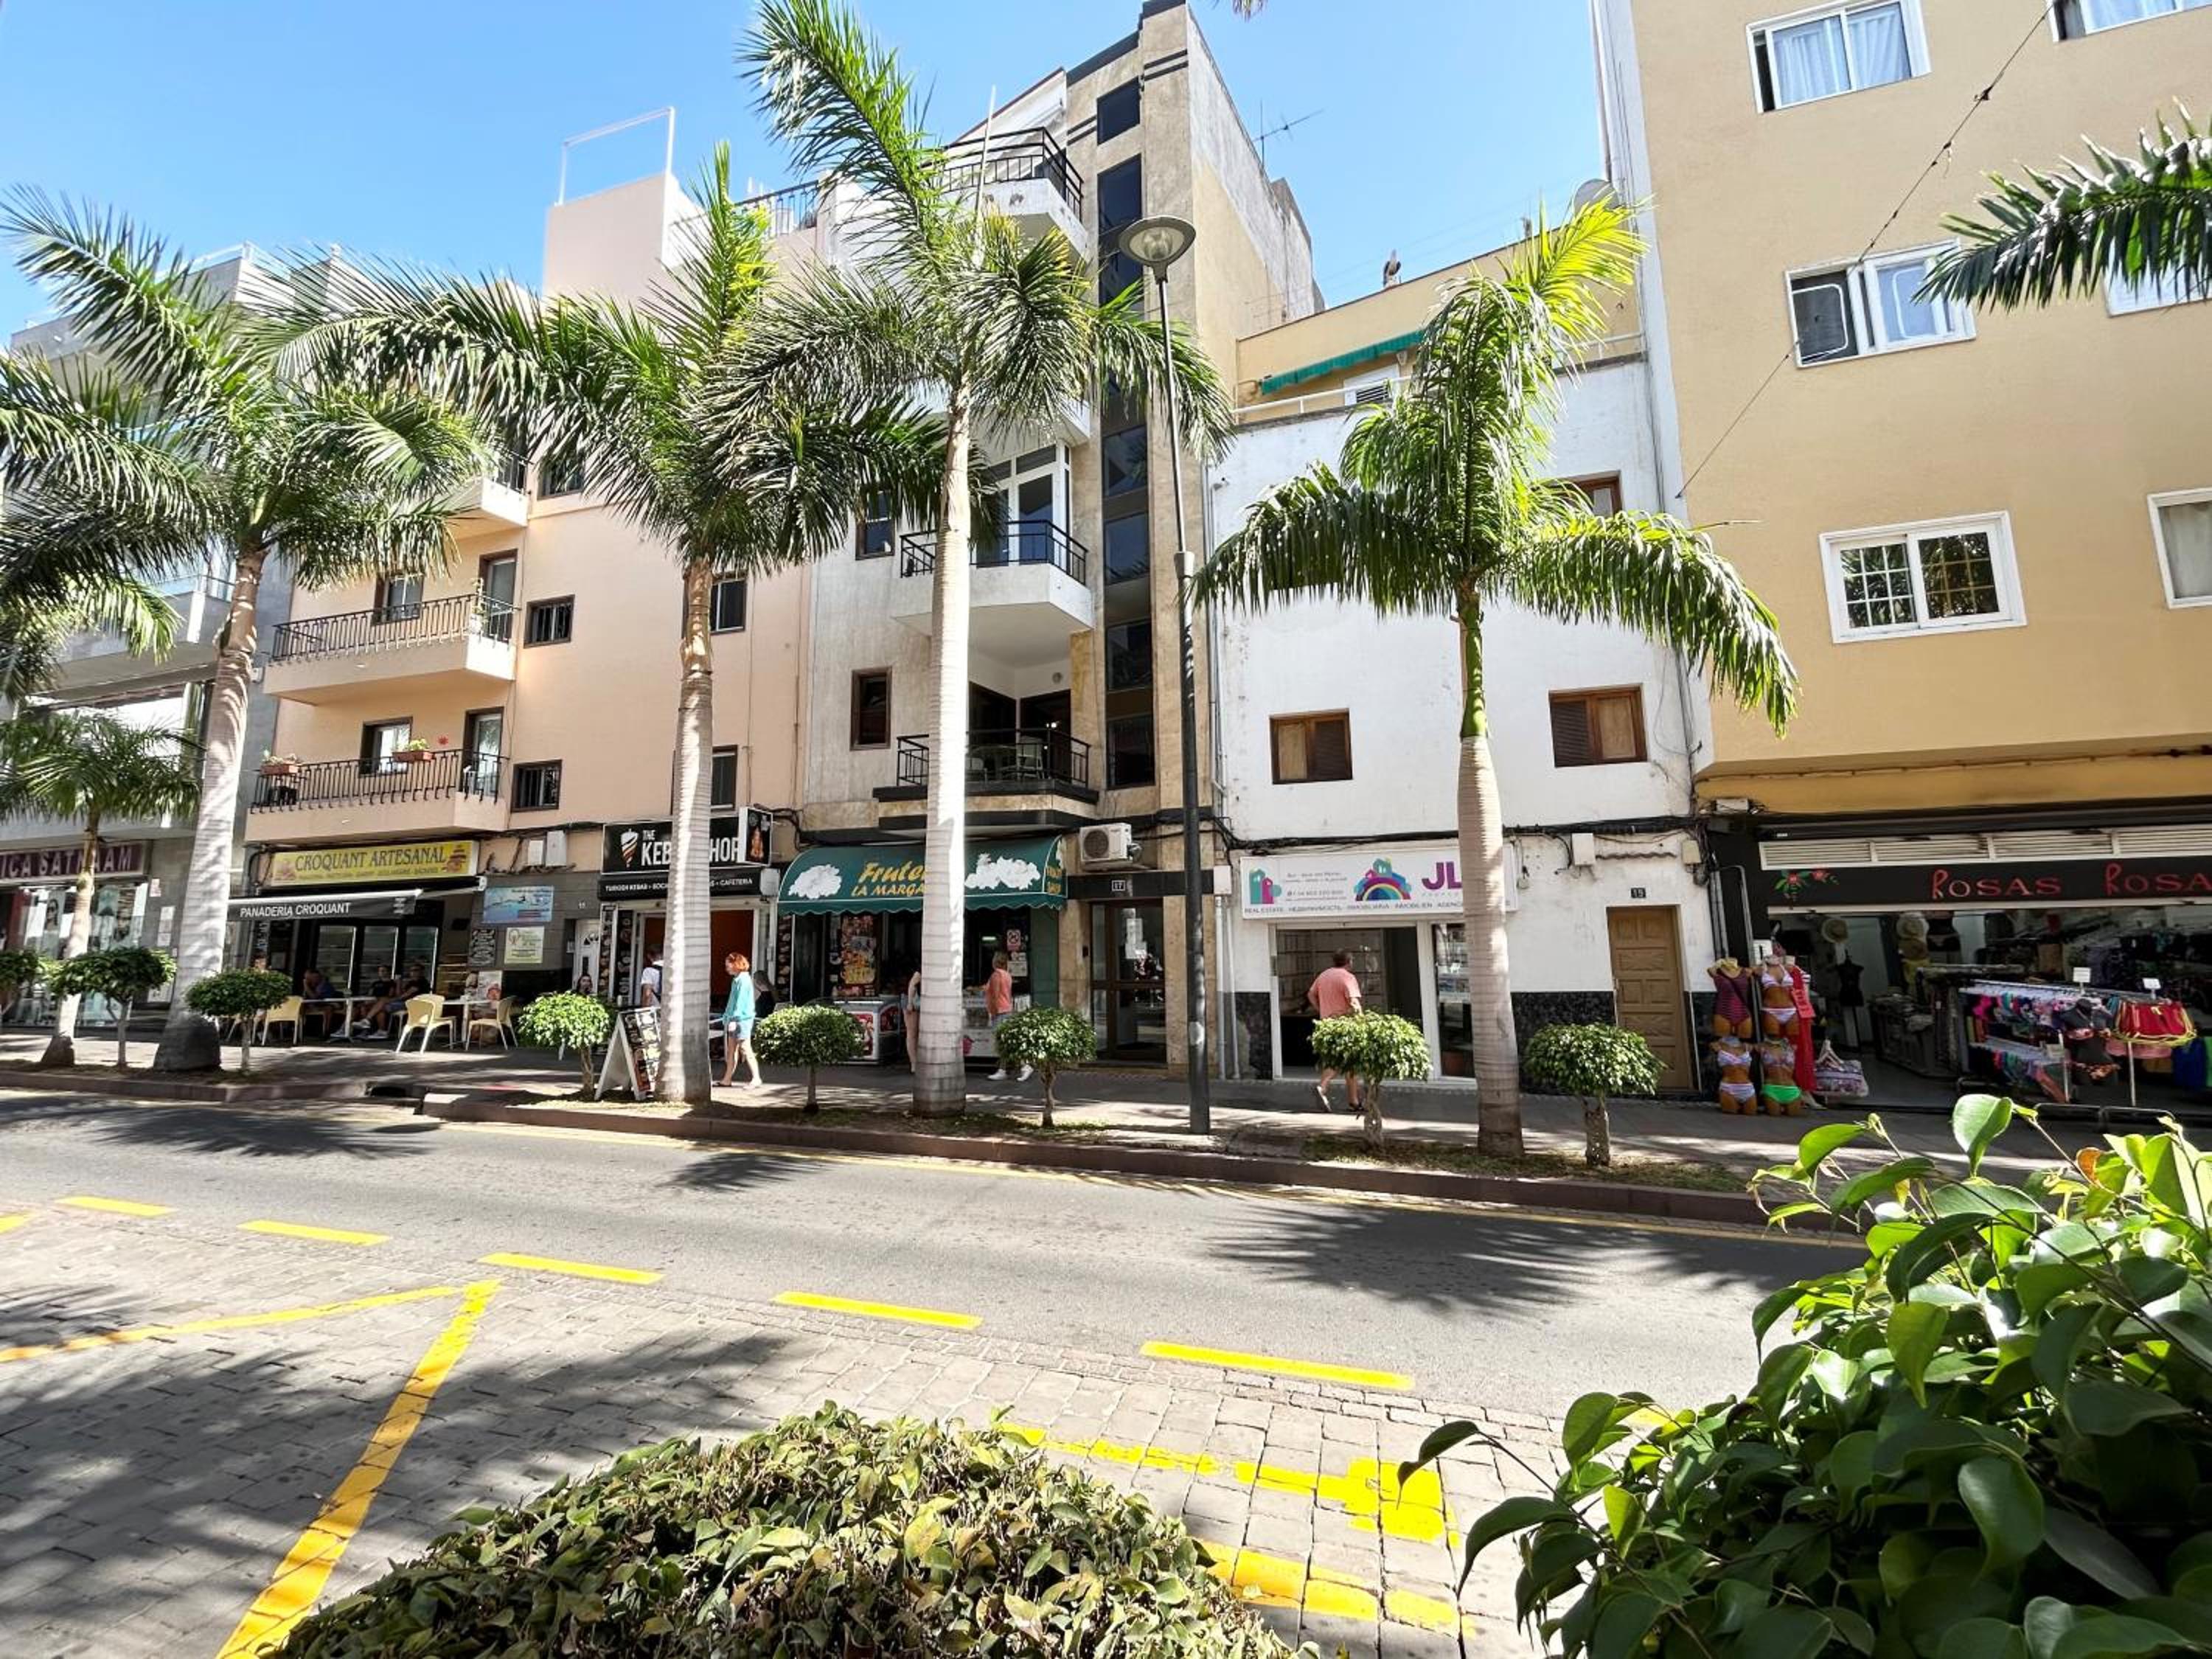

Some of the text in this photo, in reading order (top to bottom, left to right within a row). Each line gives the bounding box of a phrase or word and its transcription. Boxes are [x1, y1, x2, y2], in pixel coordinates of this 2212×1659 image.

[642, 830, 655, 841] THE
[296, 846, 446, 872] CROQUANT ARTESANAL
[641, 837, 739, 866] KEB HOP
[858, 860, 925, 883] Frute
[851, 882, 926, 897] LA MARGA
[1930, 868, 2062, 900] ROSAS
[296, 902, 352, 916] CROQUANT
